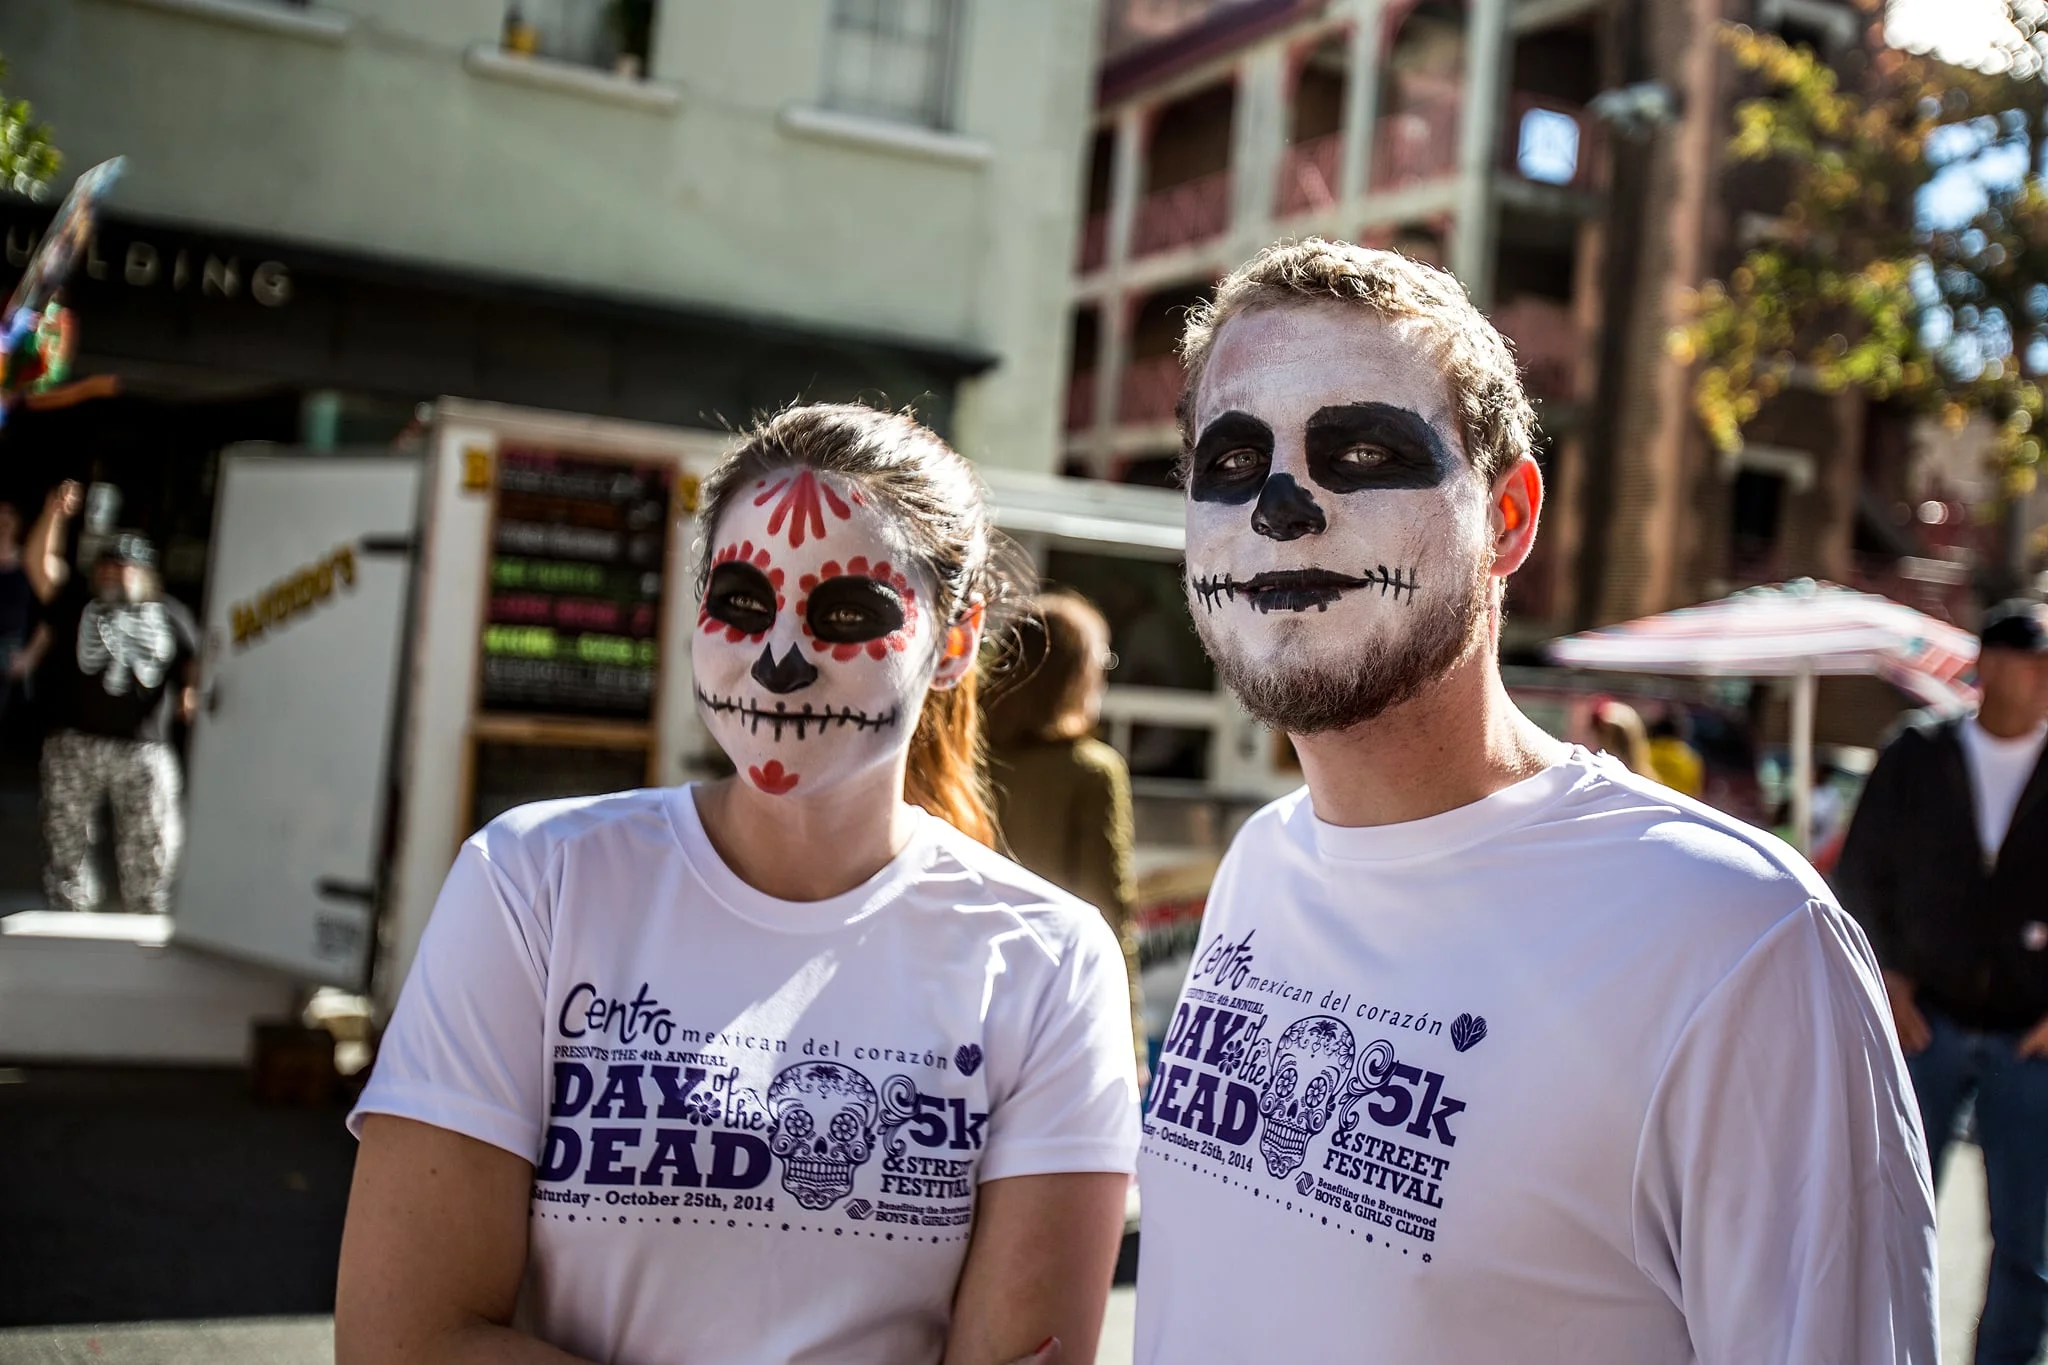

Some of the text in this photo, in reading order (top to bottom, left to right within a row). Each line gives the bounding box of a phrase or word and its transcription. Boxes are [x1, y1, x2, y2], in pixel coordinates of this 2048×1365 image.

[5, 223, 292, 308] ULDING
[1193, 929, 1254, 991] Centro
[1247, 976, 1313, 1004] mexican
[1320, 990, 1351, 1013] del
[1356, 1003, 1443, 1036] corazón
[1228, 997, 1264, 1014] ANNUAL
[558, 982, 948, 1070] Centro mexican del corazón
[1164, 1002, 1268, 1086] DAY of the
[611, 1049, 638, 1062] THE
[640, 1050, 662, 1061] 4th
[665, 1051, 728, 1067] ANNUAL
[551, 1062, 765, 1130] DAY of the
[909, 1092, 989, 1150] 5k
[1368, 1060, 1467, 1147] 5k
[537, 1124, 771, 1190] DEAD
[882, 1155, 904, 1173] &
[1161, 1126, 1200, 1152] October
[1200, 1140, 1225, 1165] 25th,
[1228, 1150, 1253, 1173] 2014
[1331, 1130, 1450, 1181] & STREET
[605, 1190, 679, 1207] October
[684, 1192, 727, 1212] 25th,
[733, 1195, 775, 1211] 2014
[1317, 1177, 1437, 1228] Benefiting the Brentwood
[1323, 1148, 1443, 1209] FESTIVAL
[875, 1210, 908, 1224] BOYS
[910, 1214, 920, 1225] &
[1314, 1189, 1436, 1242] BOYS & GIRLS CLUB
